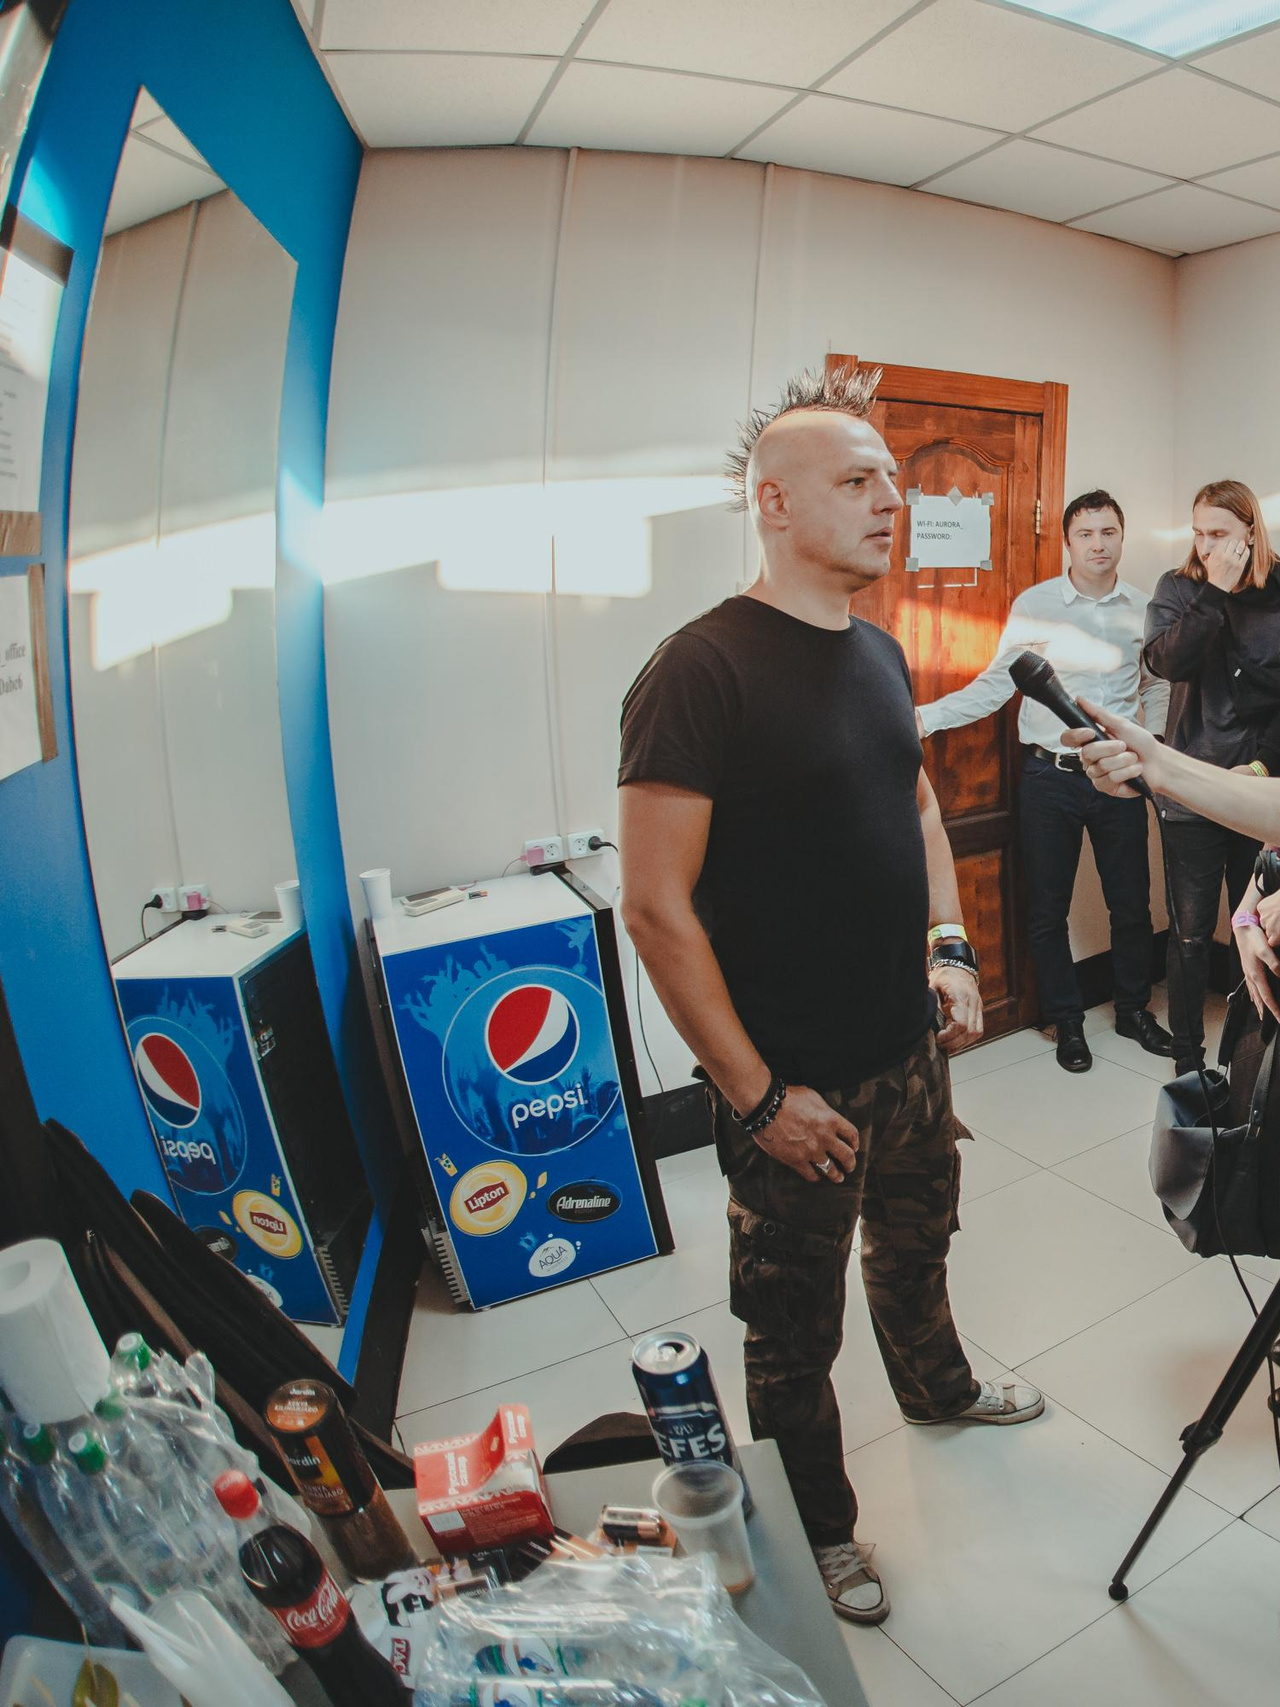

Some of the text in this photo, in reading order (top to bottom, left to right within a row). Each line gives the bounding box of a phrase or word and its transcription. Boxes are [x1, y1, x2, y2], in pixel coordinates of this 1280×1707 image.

[916, 532, 952, 541] PASSWORD:
[511, 1082, 585, 1129] pepsi
[467, 1185, 505, 1213] Lipton
[556, 1195, 611, 1213] Adrenaline
[539, 1245, 567, 1270] AQUA
[654, 1423, 726, 1458] EFES
